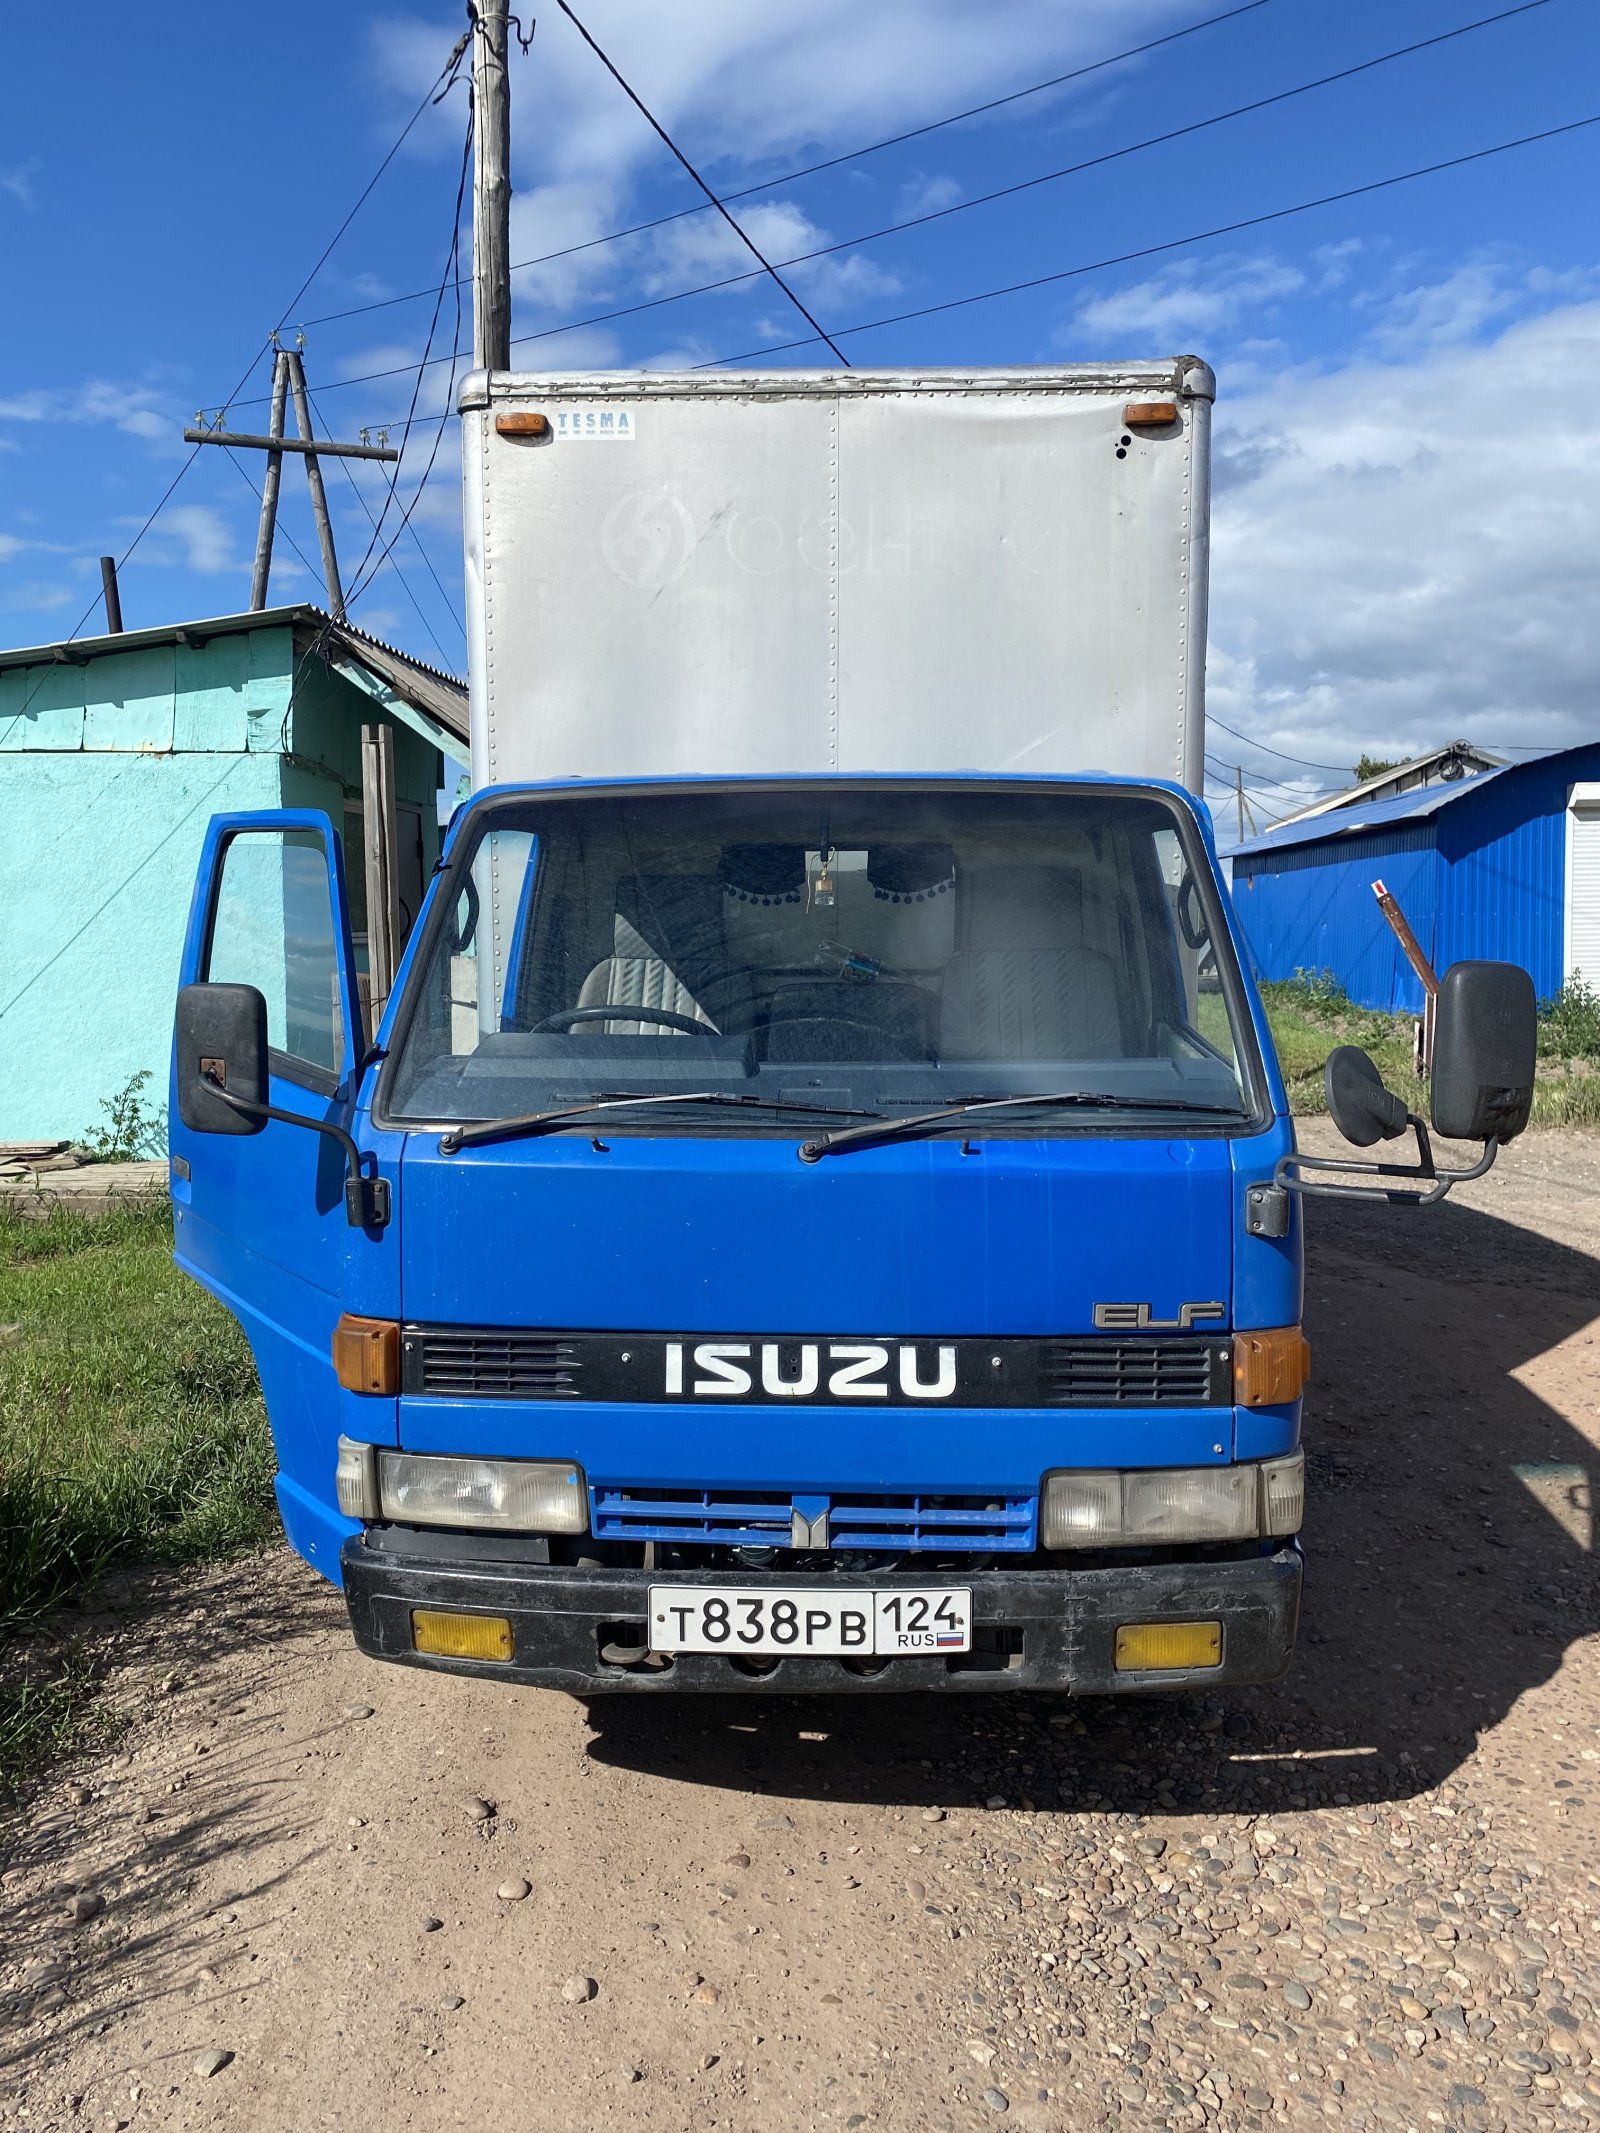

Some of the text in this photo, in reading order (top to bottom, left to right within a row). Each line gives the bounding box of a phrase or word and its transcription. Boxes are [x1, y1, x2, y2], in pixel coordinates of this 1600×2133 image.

[558, 412, 630, 429] TESMA
[1093, 1302, 1225, 1329] ELF
[665, 1343, 958, 1398] ISUZU
[882, 1595, 956, 1632] 124
[898, 1634, 935, 1647] RUS
